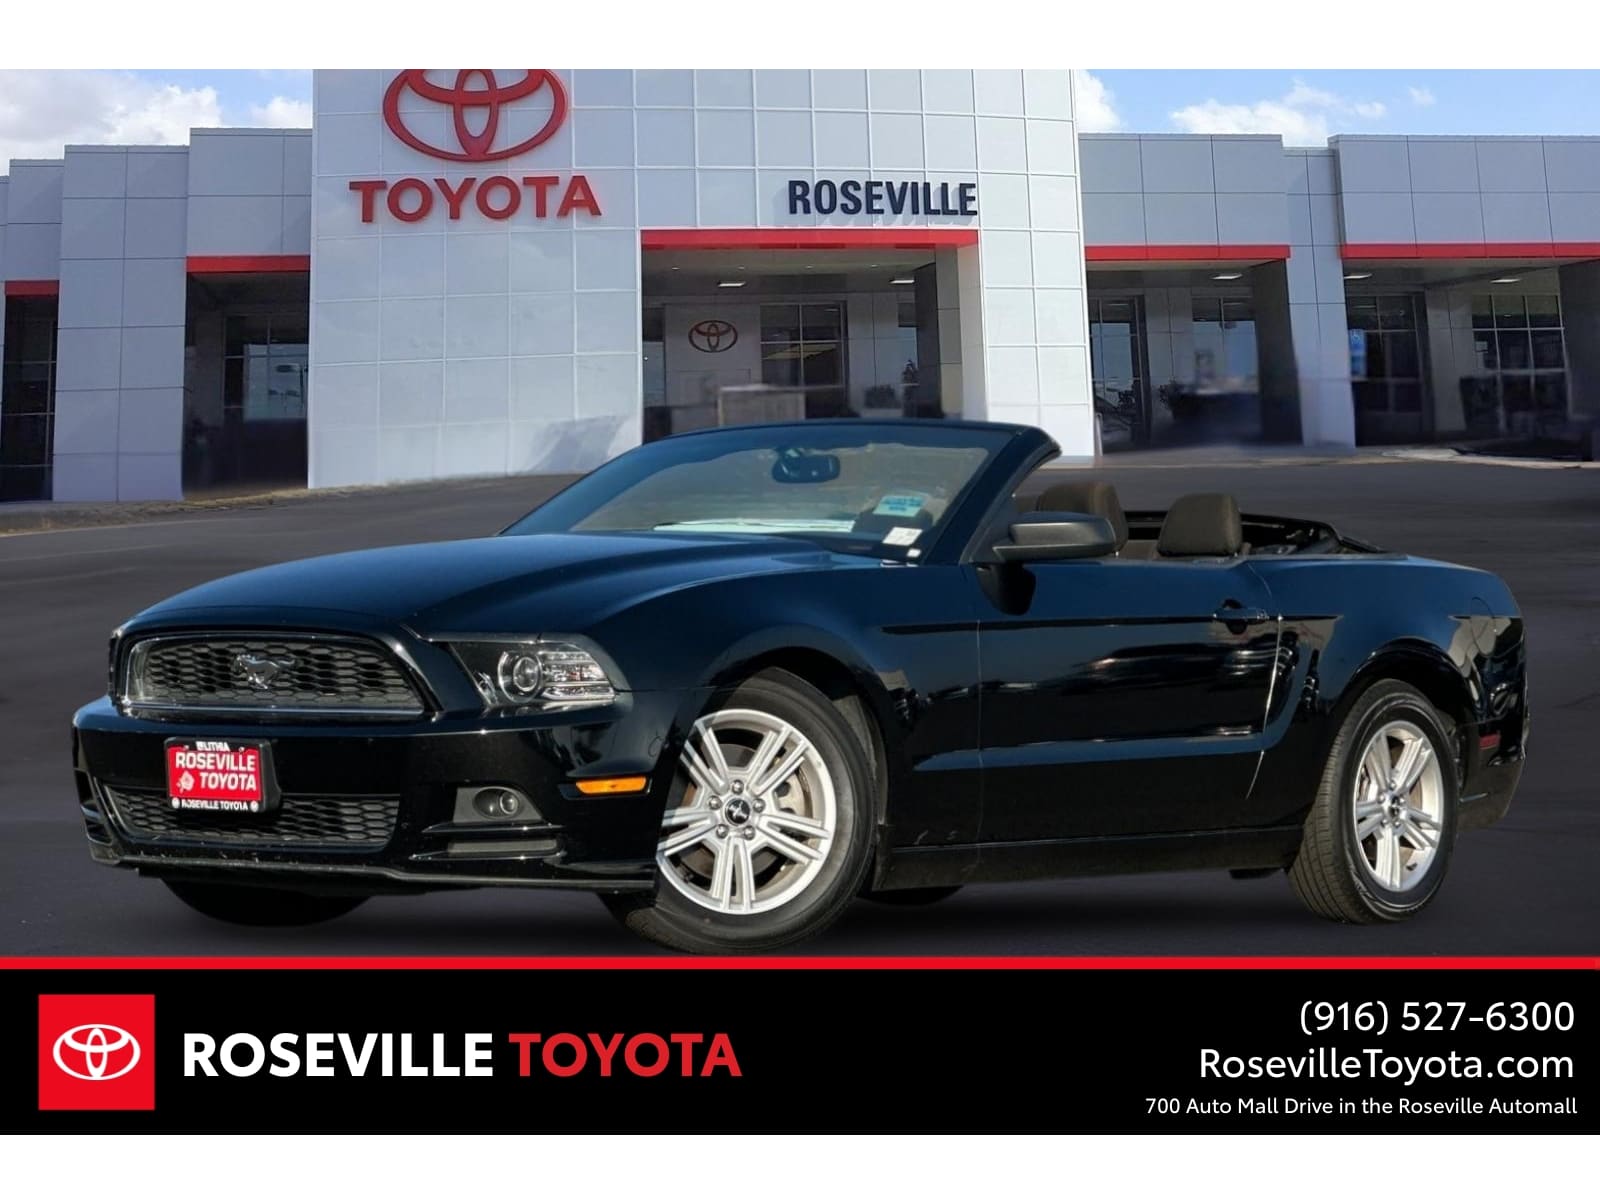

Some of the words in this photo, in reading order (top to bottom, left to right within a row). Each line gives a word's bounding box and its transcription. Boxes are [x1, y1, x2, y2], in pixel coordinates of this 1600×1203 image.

[350, 175, 602, 223] TOYOTA
[788, 180, 979, 216] ROSEVILLE
[175, 752, 256, 771] ROSEVILLE
[199, 772, 257, 791] TOYOTA
